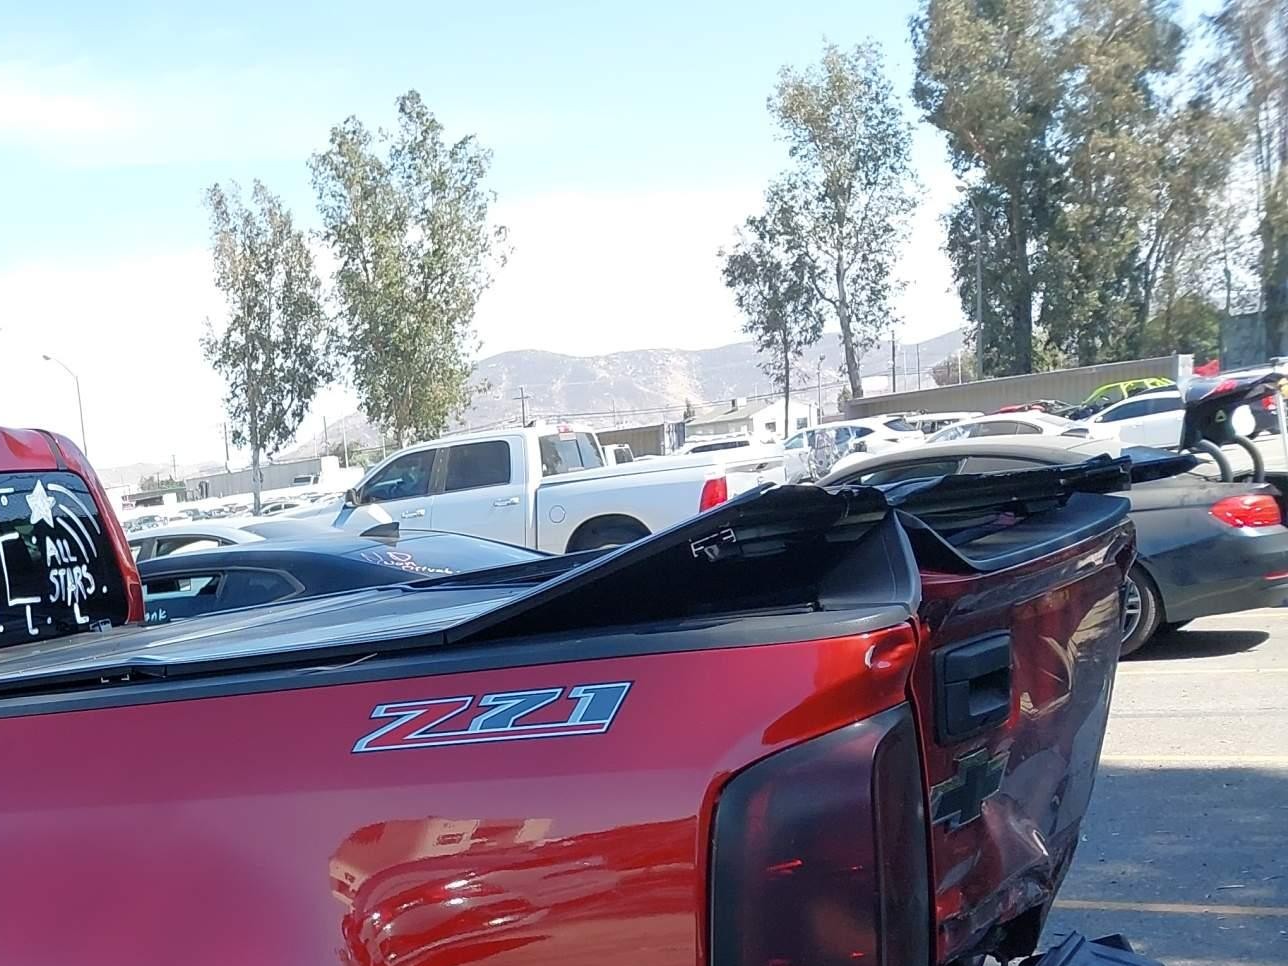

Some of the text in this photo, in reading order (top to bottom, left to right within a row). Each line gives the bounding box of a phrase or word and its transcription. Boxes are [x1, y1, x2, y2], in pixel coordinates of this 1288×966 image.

[45, 535, 78, 568] ALL
[49, 563, 96, 607] STARS
[350, 680, 636, 753] Z71
